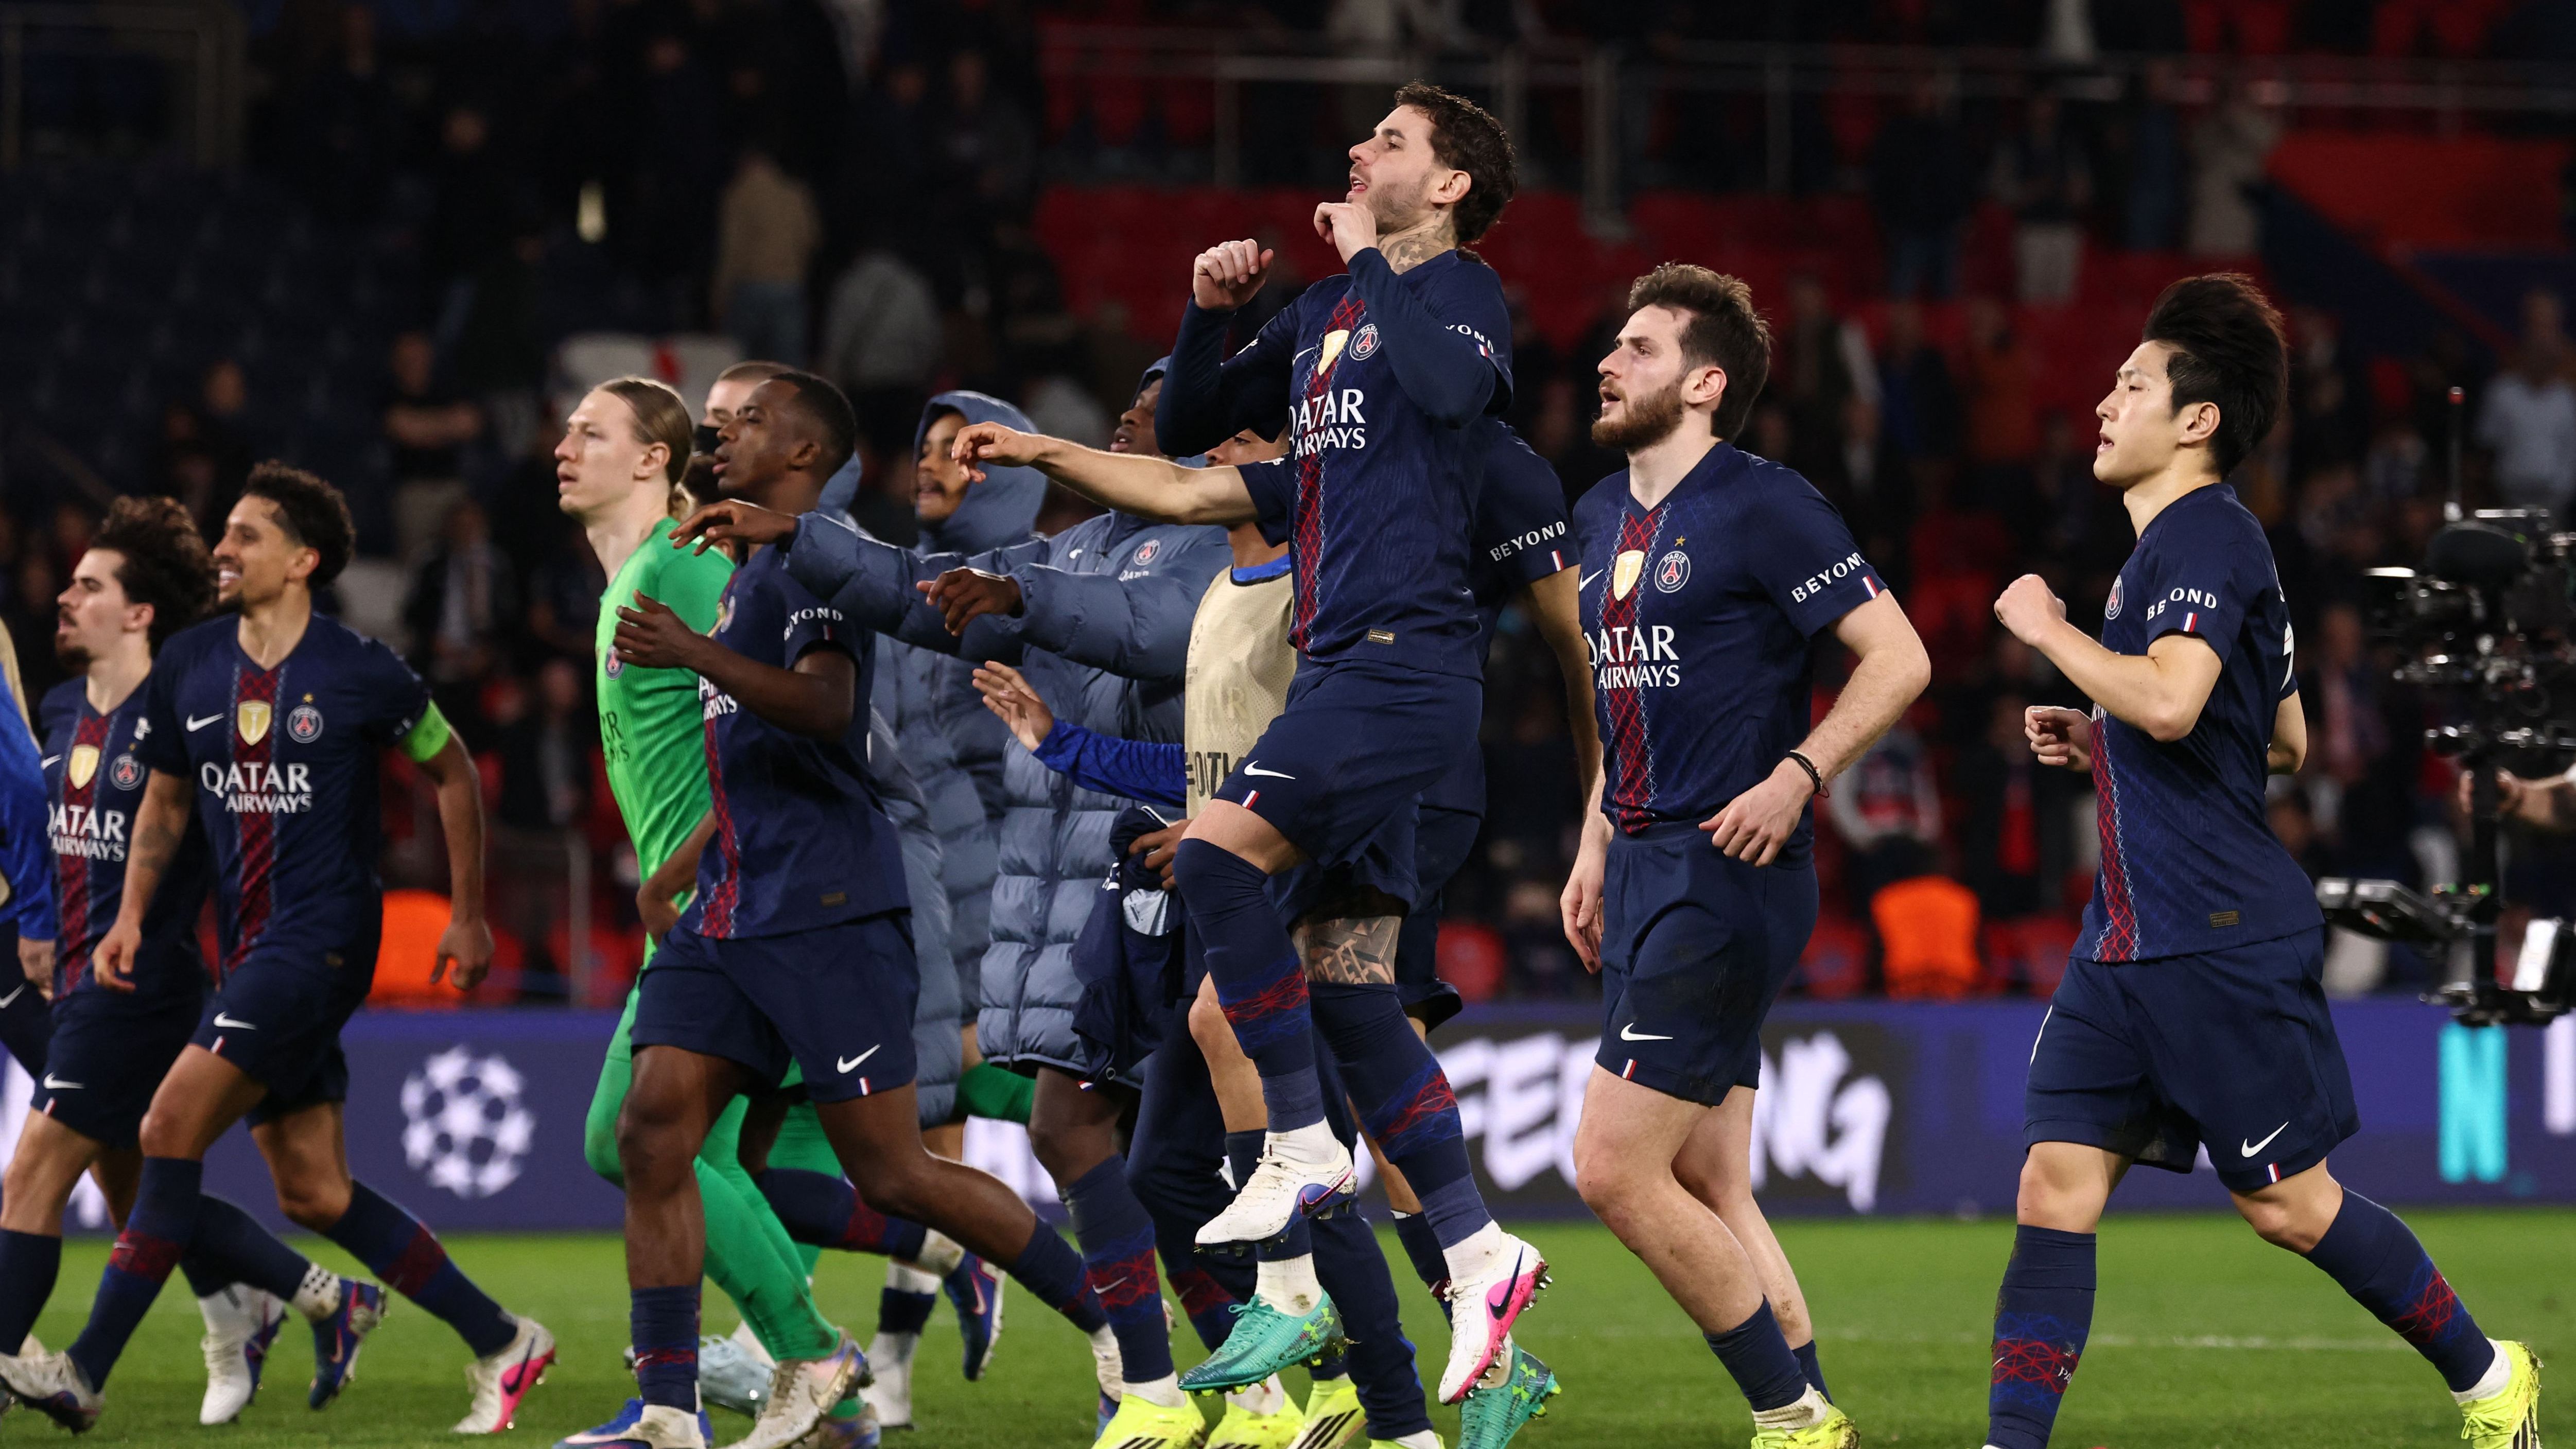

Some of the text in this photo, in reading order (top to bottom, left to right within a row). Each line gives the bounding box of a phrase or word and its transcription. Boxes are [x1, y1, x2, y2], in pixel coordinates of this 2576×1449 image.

[1289, 389, 1366, 446] QATAR
[1490, 521, 1565, 562] BEYOND
[1664, 553, 1686, 564] PARIS
[2147, 588, 2217, 622] BEOND
[1598, 665, 1680, 689] AIRWAYS
[201, 761, 312, 799] QATAR
[225, 793, 313, 814] AIRWAYS
